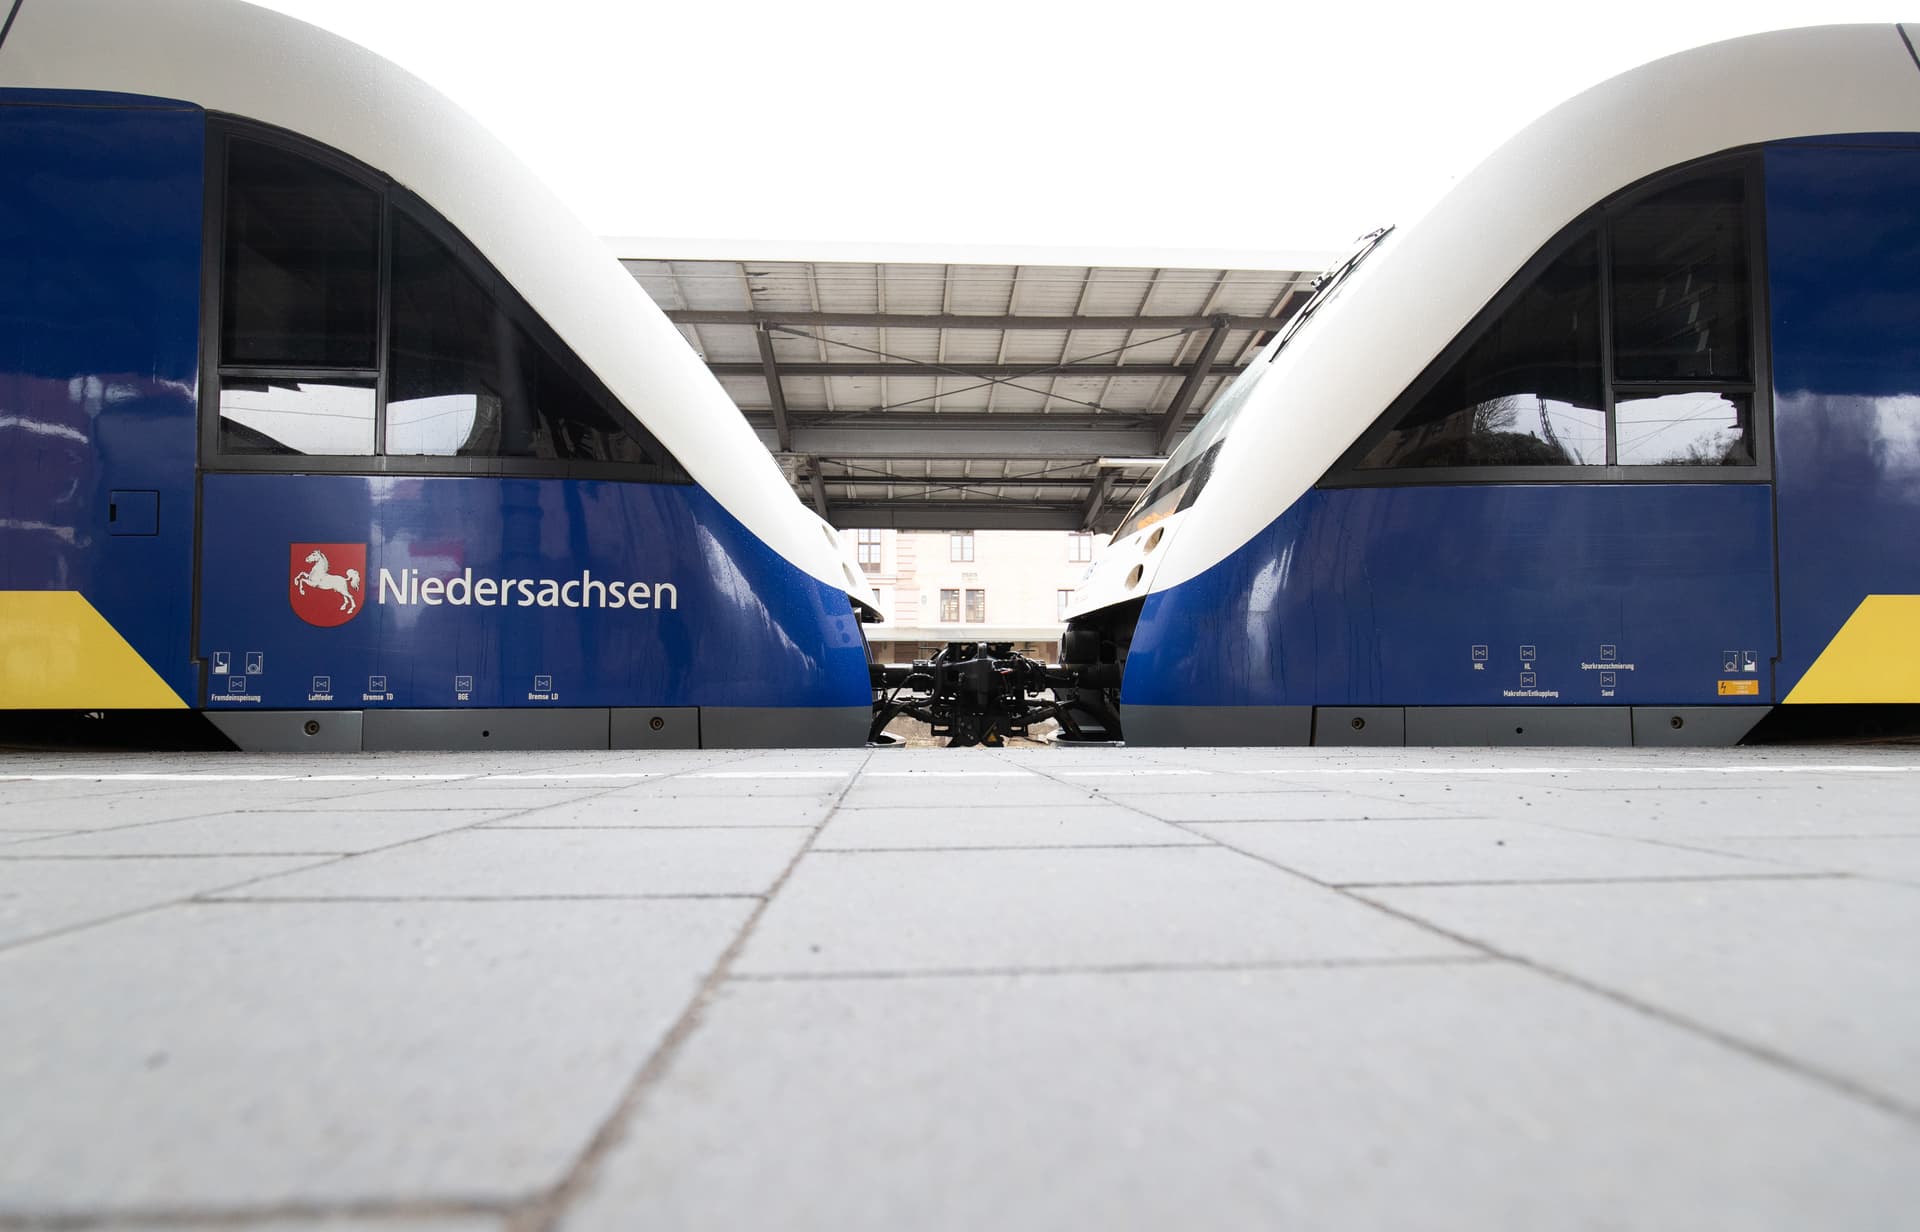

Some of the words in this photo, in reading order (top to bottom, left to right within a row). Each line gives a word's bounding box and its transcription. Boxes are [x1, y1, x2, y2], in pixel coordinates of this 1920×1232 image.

[378, 567, 678, 610] Niedersachsen
[1581, 662, 1634, 671] Spurkranzschmierung
[308, 693, 334, 701] Luftfeder
[362, 693, 384, 701] Bremse
[386, 693, 394, 701] TD
[457, 692, 469, 701] BGE
[528, 692, 549, 700] Bremse
[551, 692, 559, 700] LD
[1503, 690, 1559, 698] Makrofon/Entkupplung
[1601, 689, 1615, 697] Sand
[211, 693, 261, 703] Fremdeinspeisung
